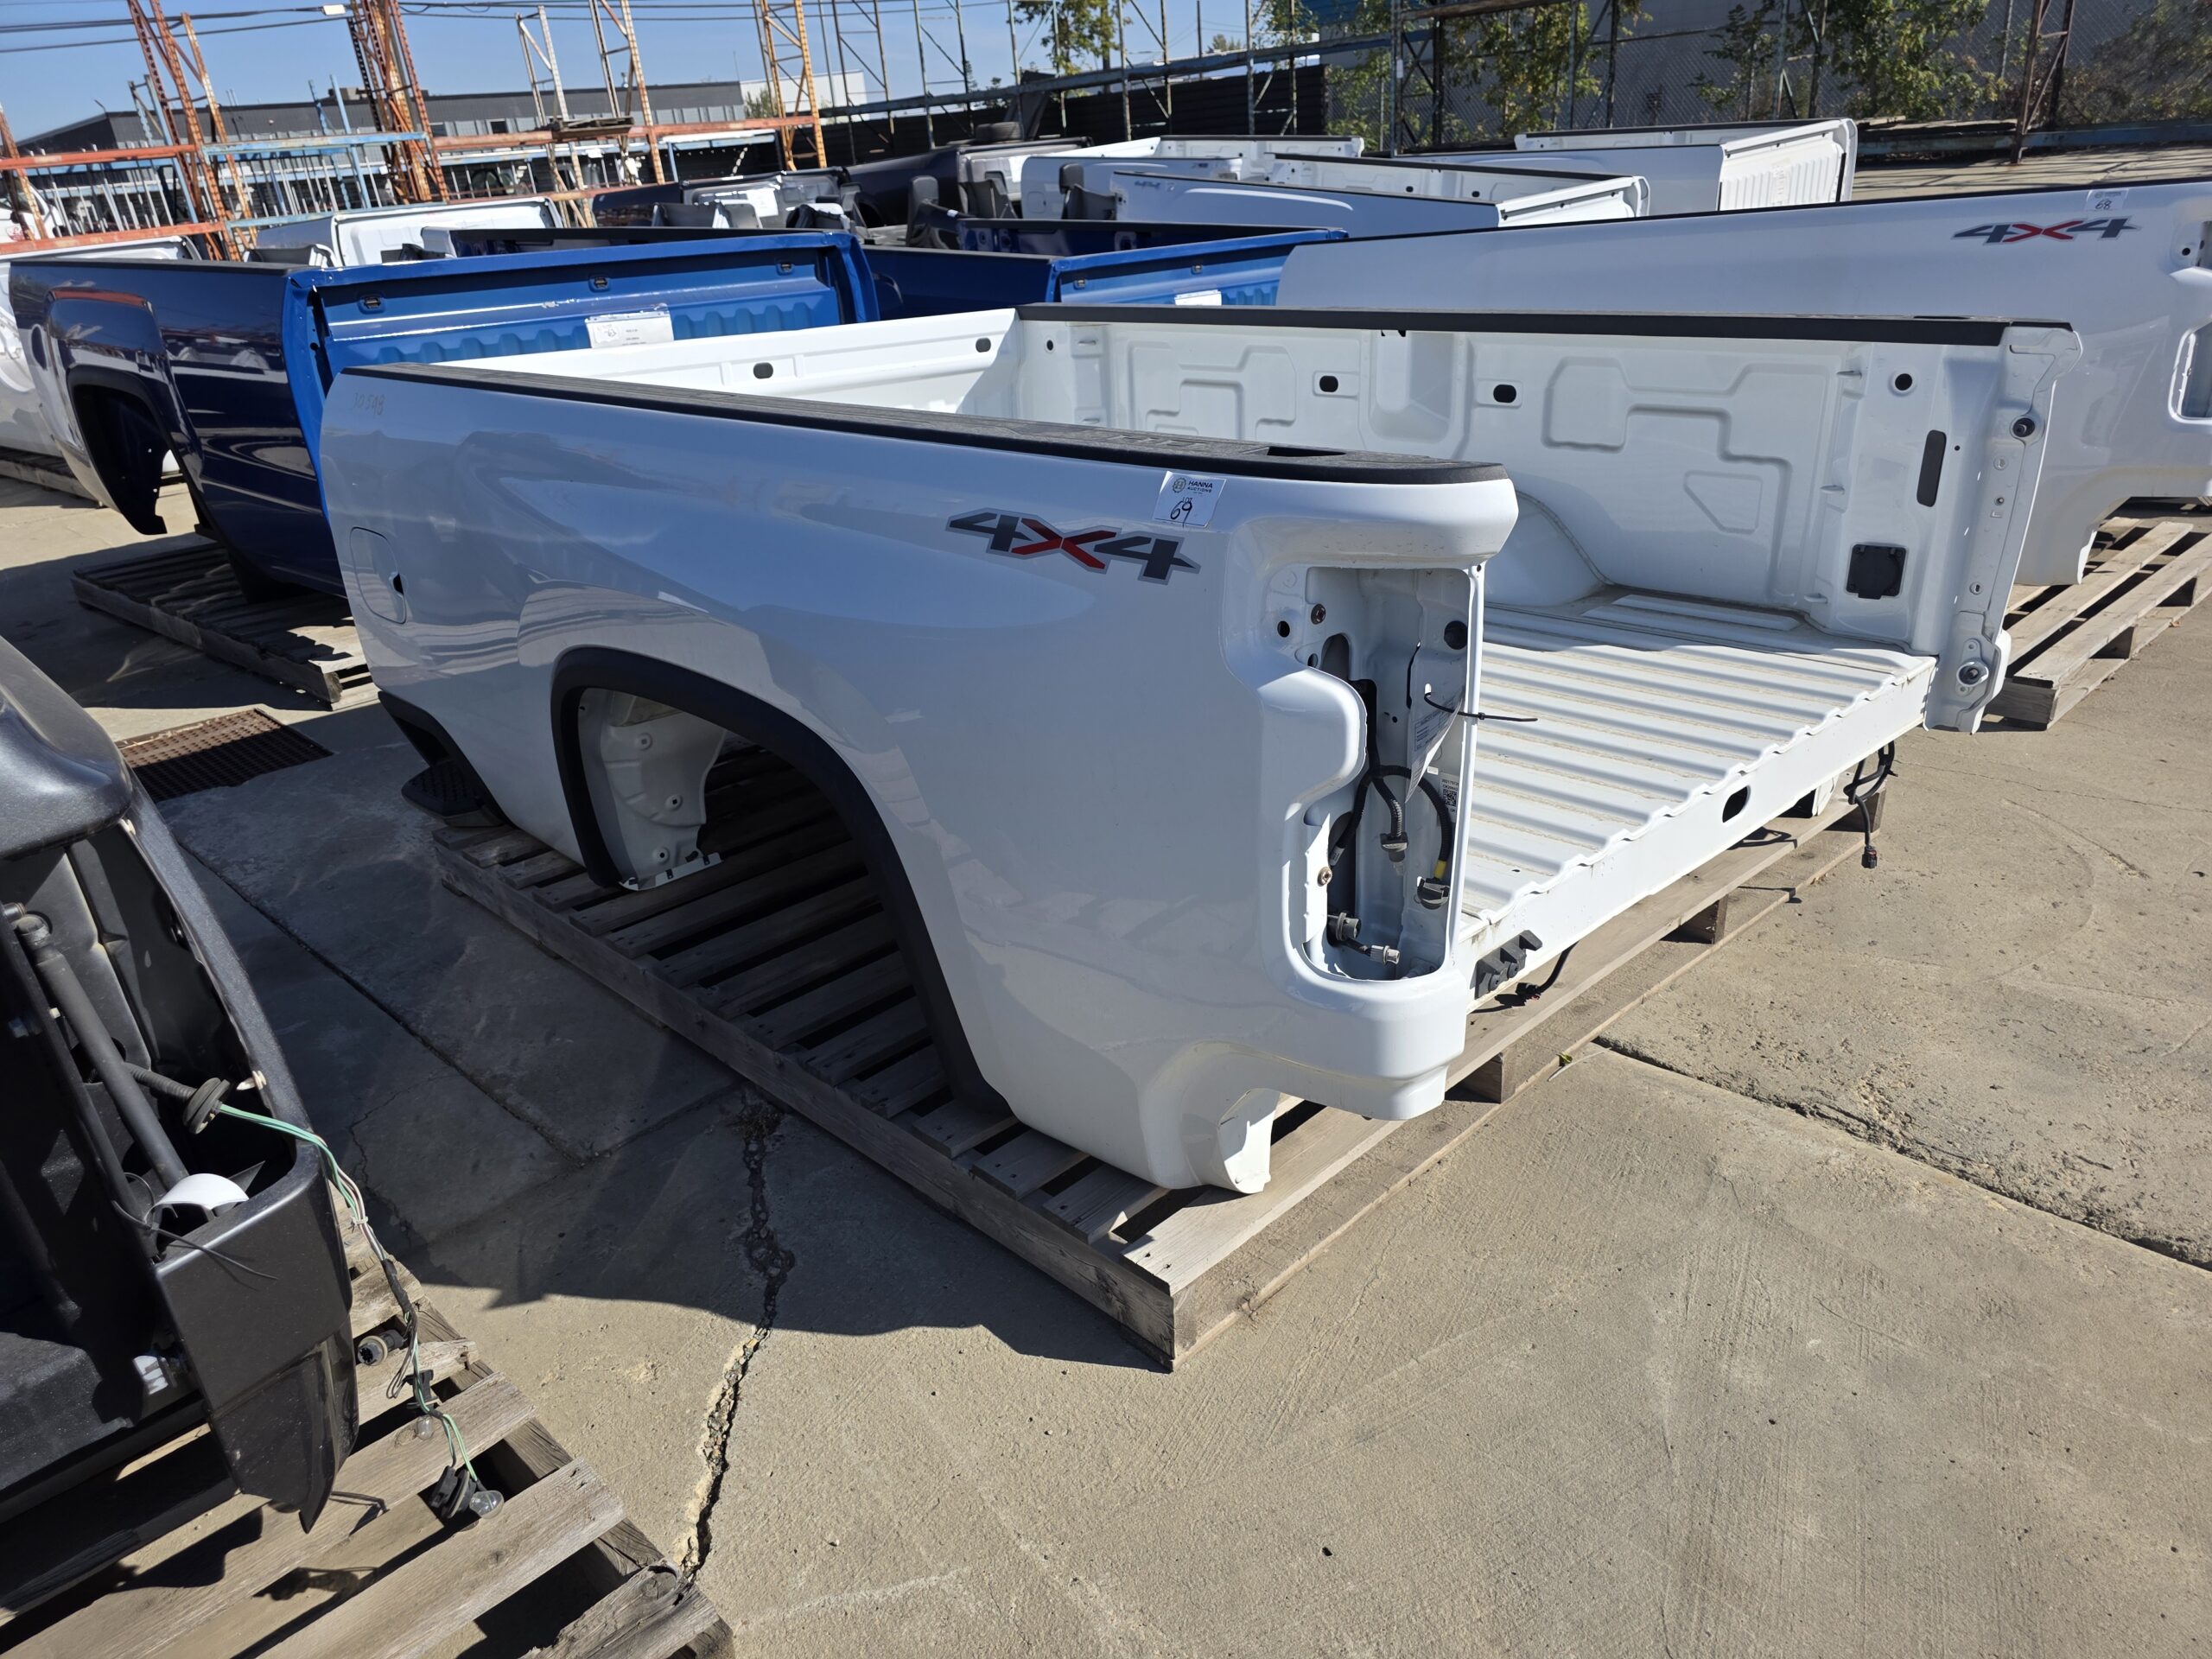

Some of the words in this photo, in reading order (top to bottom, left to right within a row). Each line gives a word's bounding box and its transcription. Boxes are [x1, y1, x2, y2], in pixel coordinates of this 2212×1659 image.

[2095, 200, 2112, 210] 68
[1188, 480, 1213, 489] HANNA
[1170, 500, 1192, 528] 69
